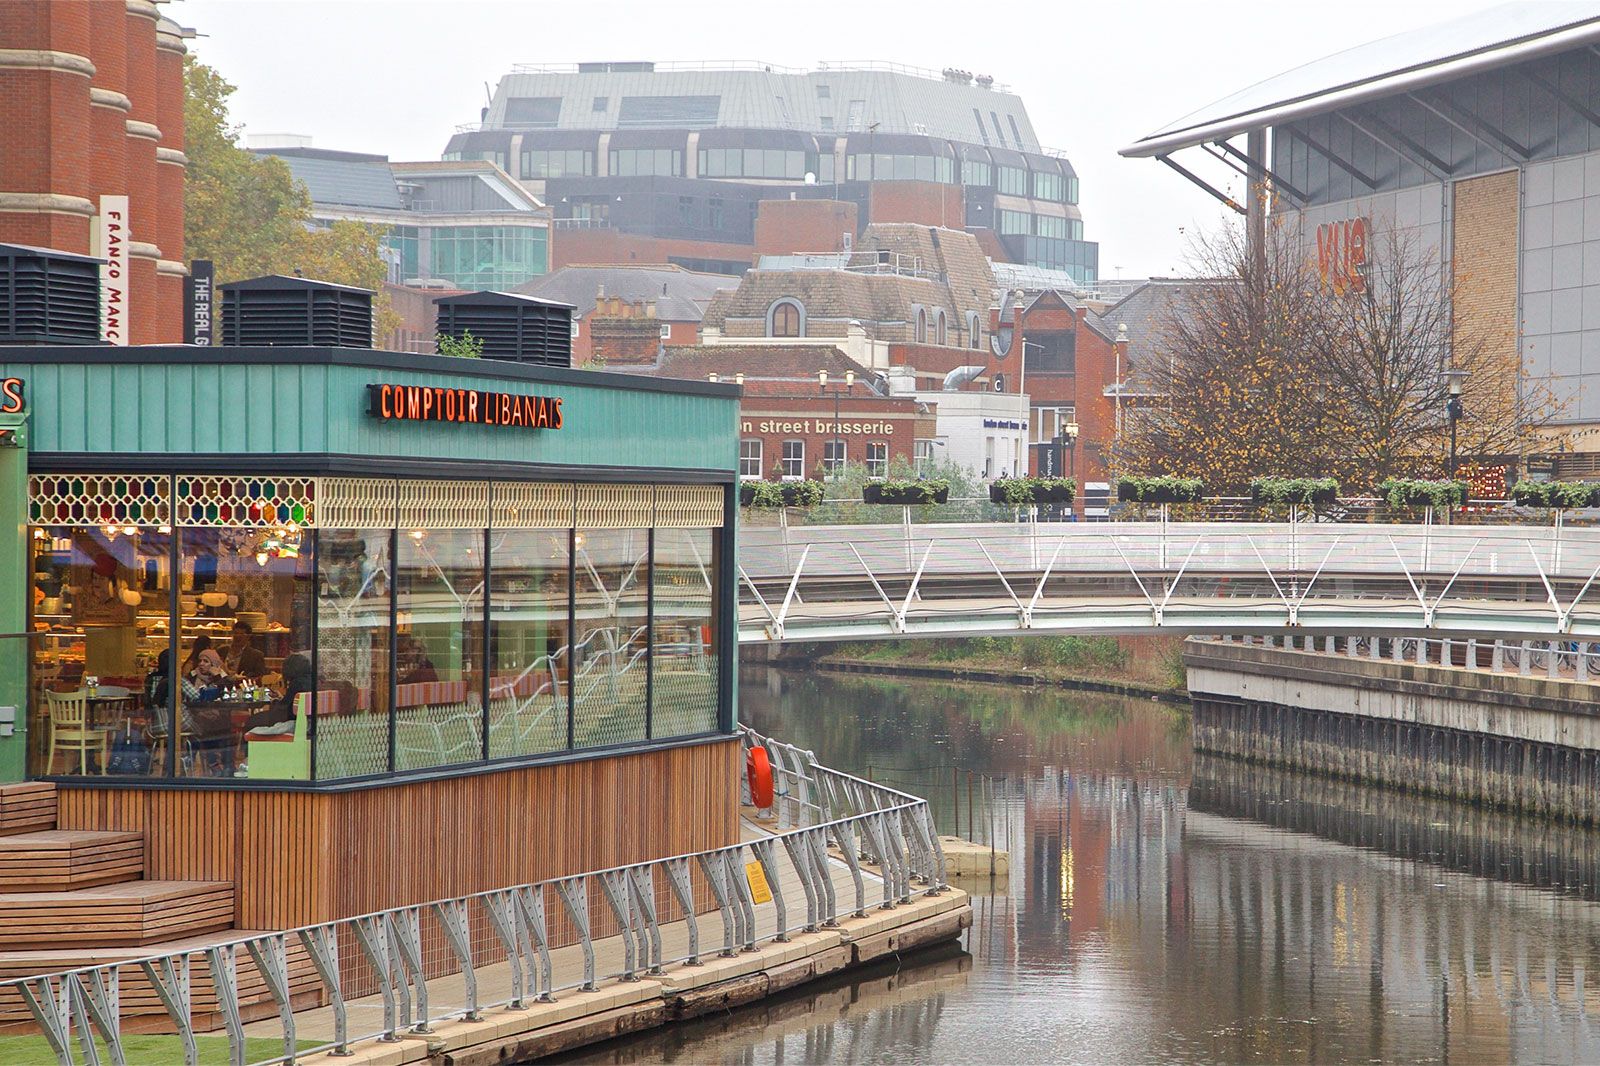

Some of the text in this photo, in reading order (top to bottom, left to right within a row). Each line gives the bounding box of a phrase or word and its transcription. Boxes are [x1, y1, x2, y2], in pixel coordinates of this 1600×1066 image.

[107, 211, 121, 279] FRANCO
[194, 276, 209, 301] THE
[194, 303, 209, 336] REAL
[381, 383, 564, 430] COMPTOIR LIBANAIS
[759, 419, 811, 434] street
[815, 419, 894, 435] brasserie
